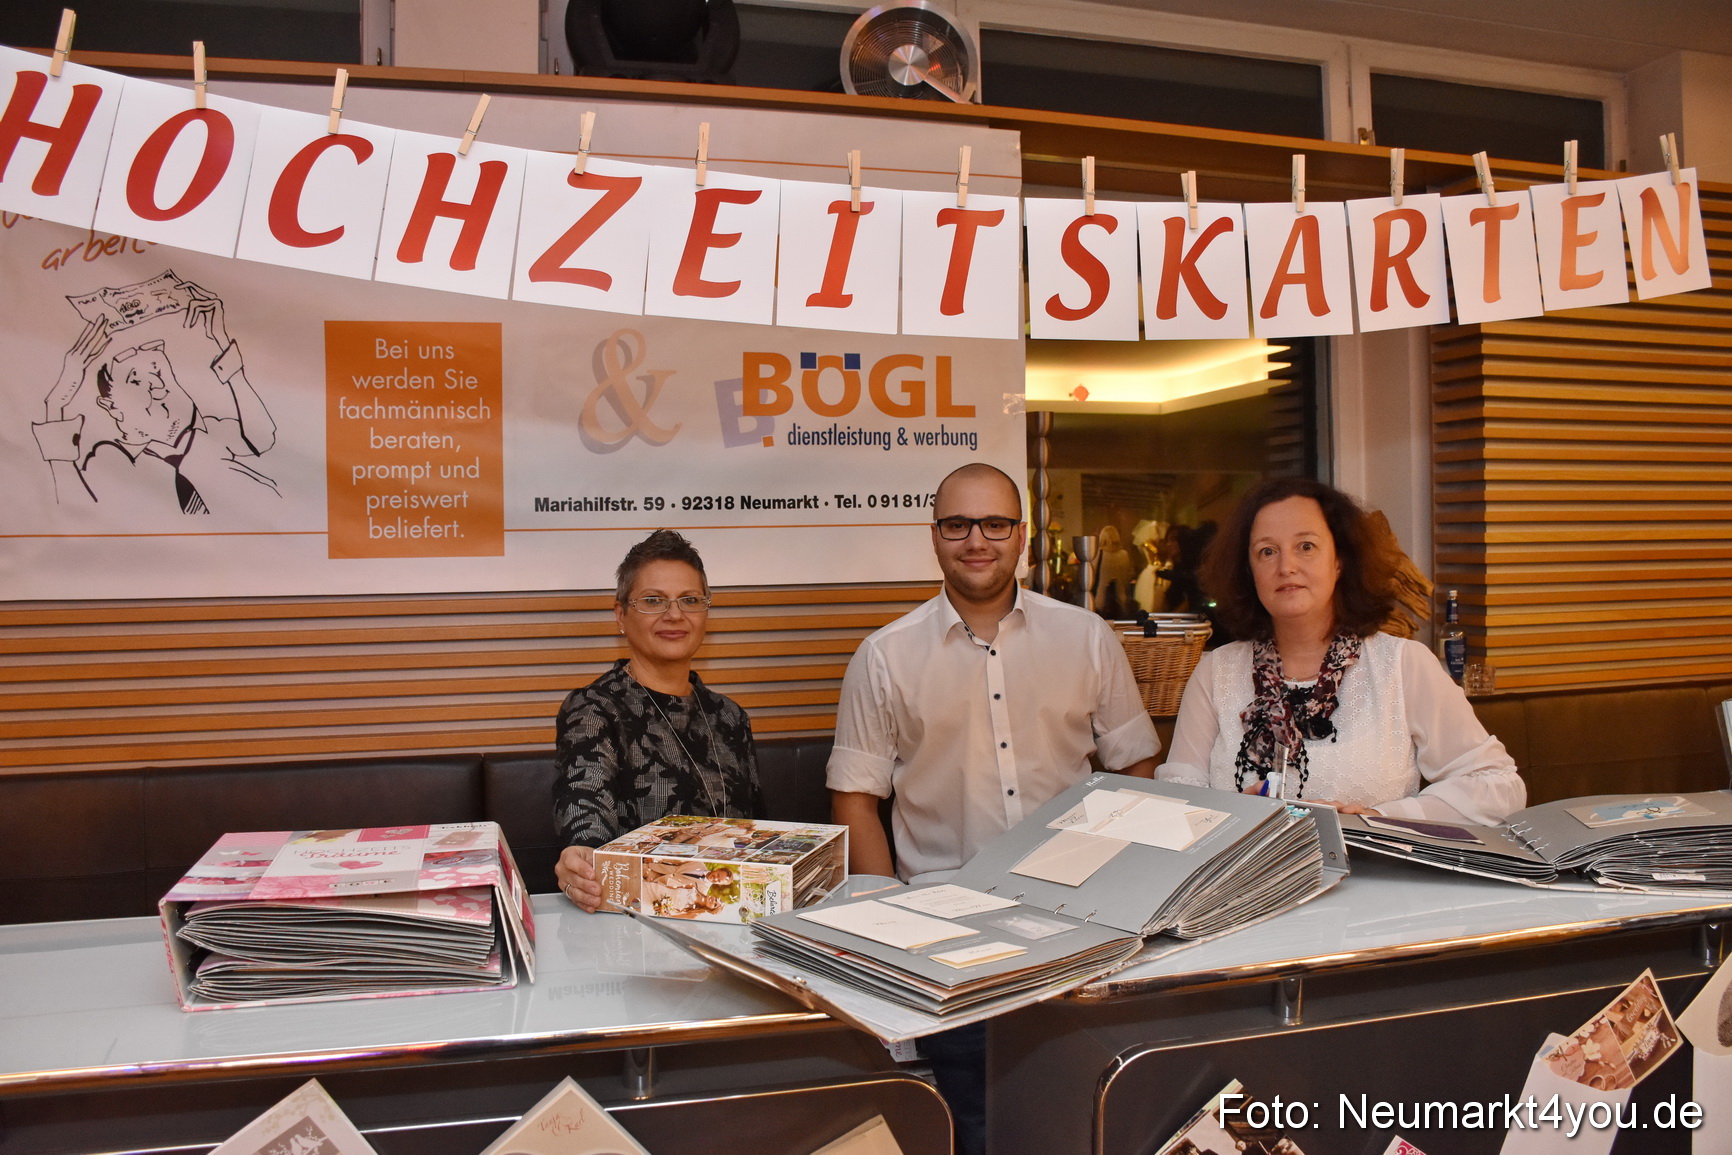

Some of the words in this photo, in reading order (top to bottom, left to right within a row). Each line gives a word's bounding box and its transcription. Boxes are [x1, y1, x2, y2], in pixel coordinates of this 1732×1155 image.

[375, 338, 409, 360] Bei
[418, 345, 455, 360] uns
[352, 367, 436, 390] werden
[444, 368, 478, 390] Sie
[742, 351, 977, 418] BÖGL
[339, 397, 491, 420] fachmännisch
[370, 427, 461, 453] beraten,
[787, 423, 892, 451] dienstleistung
[896, 426, 910, 446] &
[913, 424, 979, 452] werbung
[352, 461, 432, 485] prompt
[440, 457, 480, 479] und
[366, 490, 469, 516] preiswert
[534, 496, 638, 513] Mariahilfstr.
[643, 496, 666, 511] 59
[681, 496, 735, 511] 92318
[740, 495, 820, 511] Neumarkt
[833, 494, 862, 510] Tel.
[369, 516, 465, 539] beliefert.
